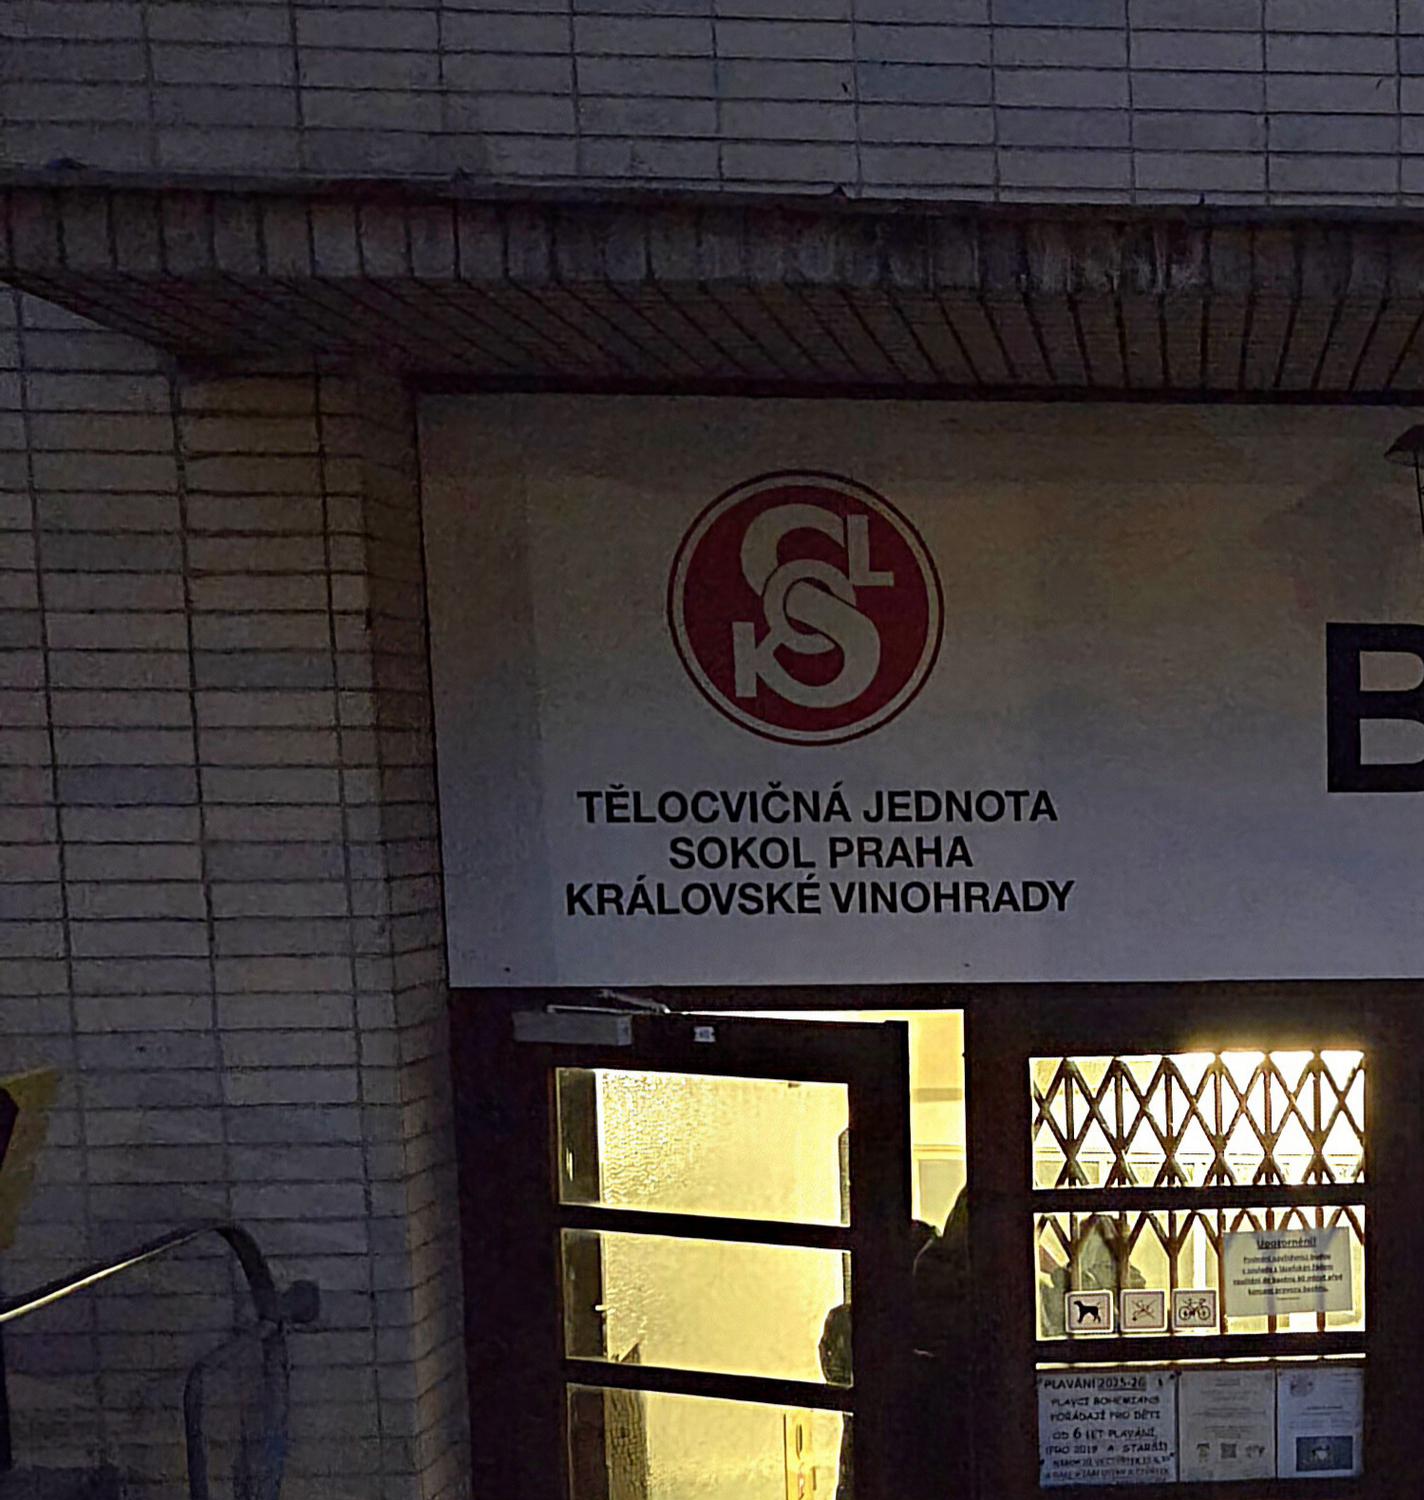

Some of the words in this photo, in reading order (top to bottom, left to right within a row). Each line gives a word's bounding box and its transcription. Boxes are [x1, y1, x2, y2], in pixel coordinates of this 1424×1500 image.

[576, 780, 851, 824] TĚLOCVIČNÁ
[863, 789, 1058, 823] JEDNOTA
[669, 837, 816, 869] SOKOL
[828, 836, 973, 868] PRAHA
[565, 873, 821, 916] KRÁLOVSKÉ
[830, 879, 1076, 914] VINOHRADY
